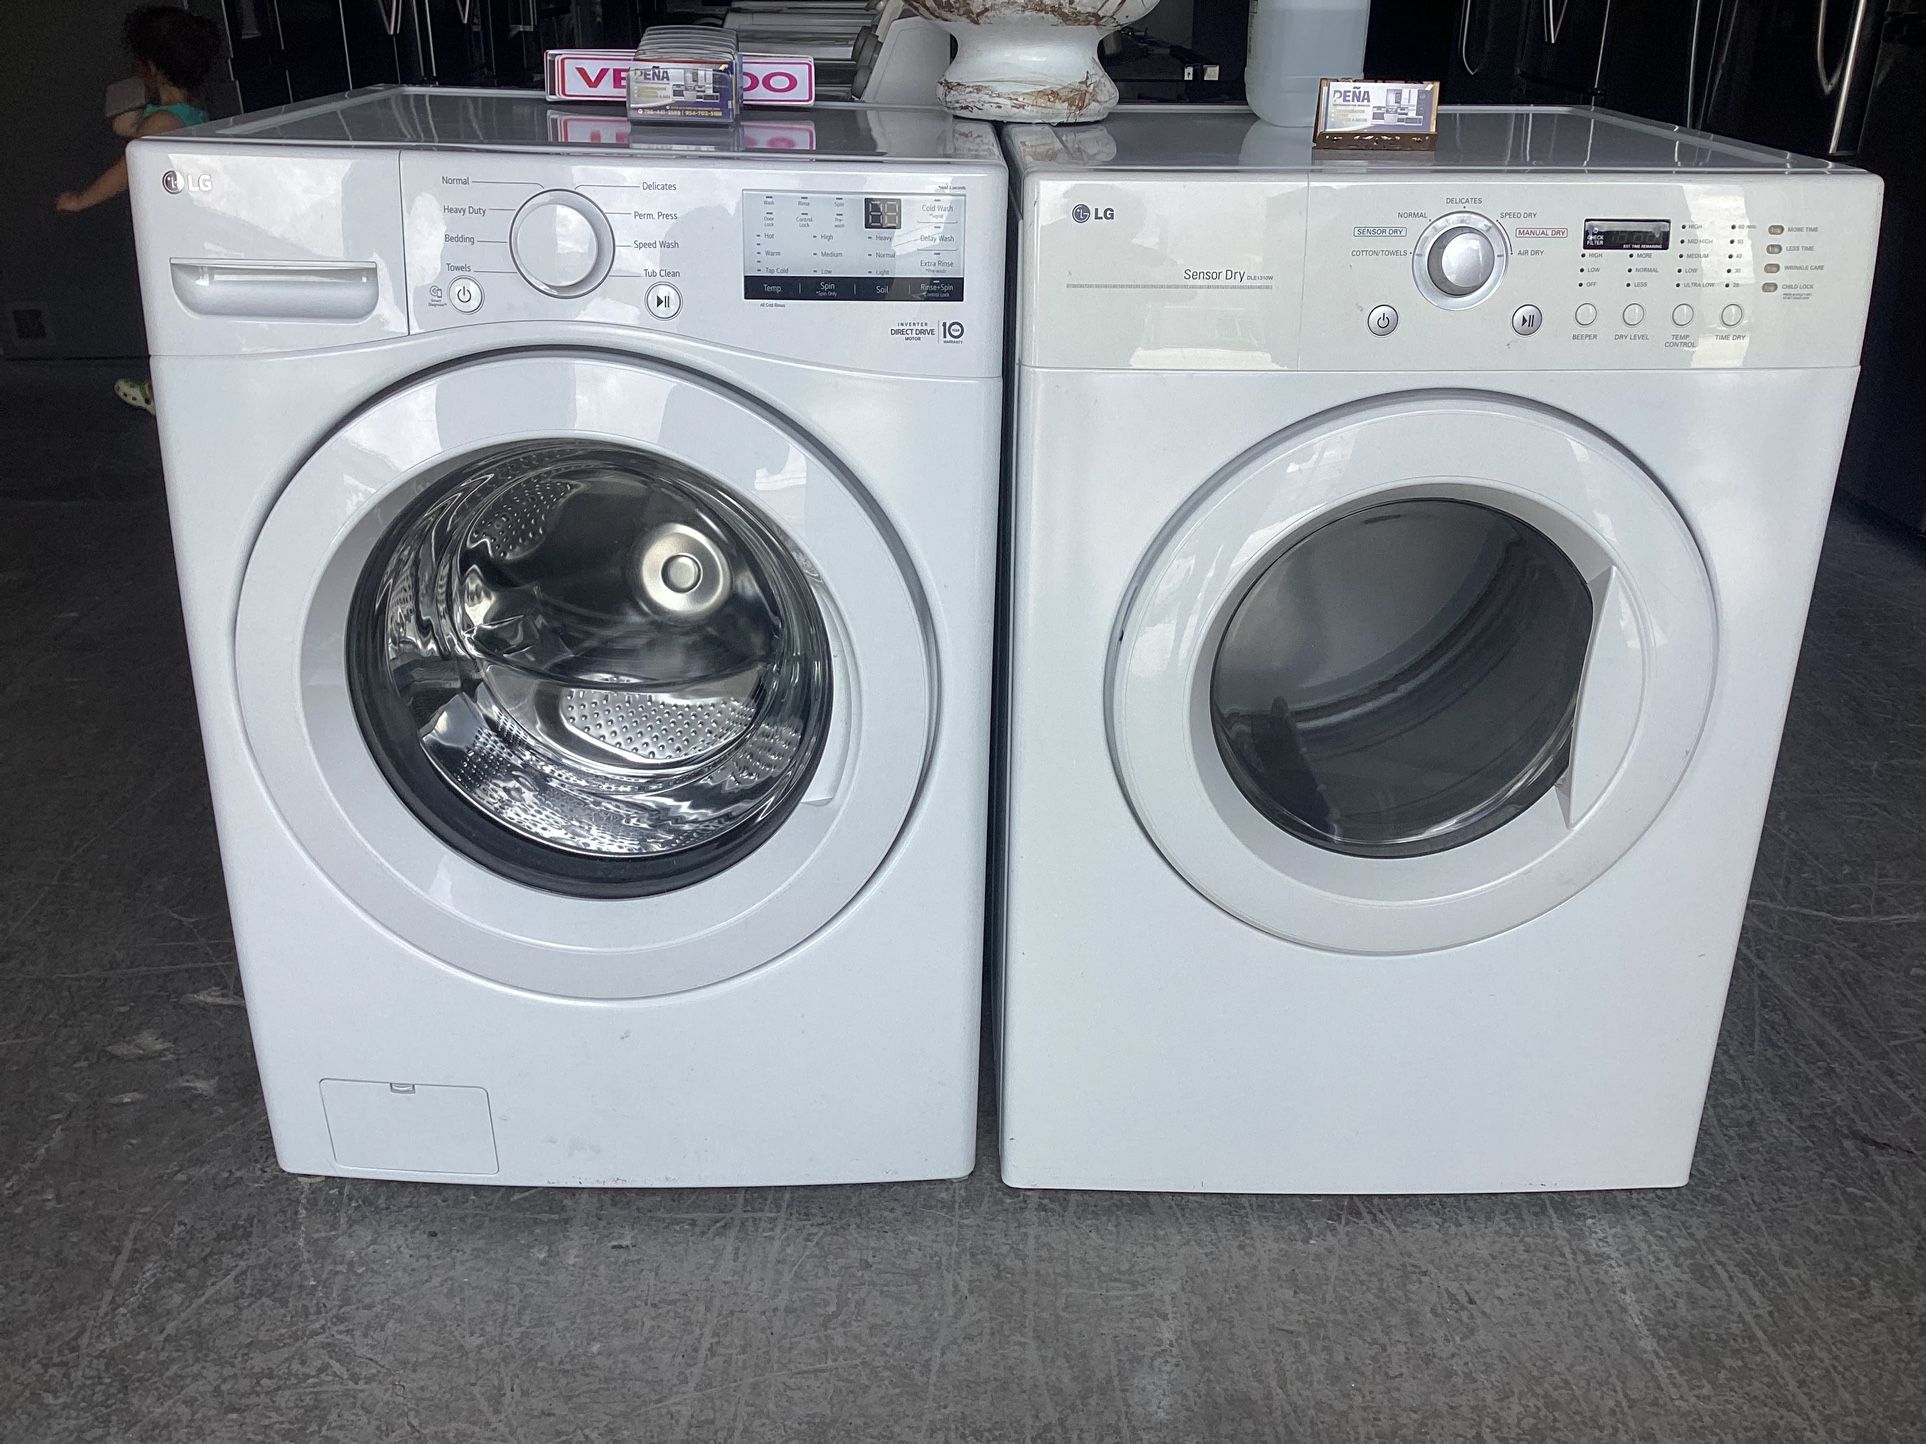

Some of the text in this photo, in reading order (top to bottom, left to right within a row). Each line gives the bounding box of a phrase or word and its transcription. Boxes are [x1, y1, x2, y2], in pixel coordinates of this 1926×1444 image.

[634, 66, 670, 80] PEÑA
[575, 66, 798, 93] VEDO
[1333, 86, 1370, 102] PEÑA
[188, 174, 212, 191] LG
[442, 176, 470, 185] Normal
[642, 182, 677, 190] Delicates
[444, 205, 486, 216] Heavy Duty
[1094, 208, 1114, 220] LG
[634, 212, 678, 220] Perm. Press
[444, 234, 475, 245] Bedding
[634, 240, 679, 250] Speed Wash
[446, 263, 471, 272] Towels
[643, 269, 680, 277] Tub Clean
[1184, 269, 1222, 281] Sensor
[1225, 270, 1246, 282] Dry
[820, 282, 835, 290] Spin
[876, 286, 889, 294] Soil
[920, 283, 954, 292] Rinse+Spin
[942, 321, 964, 339] 10
